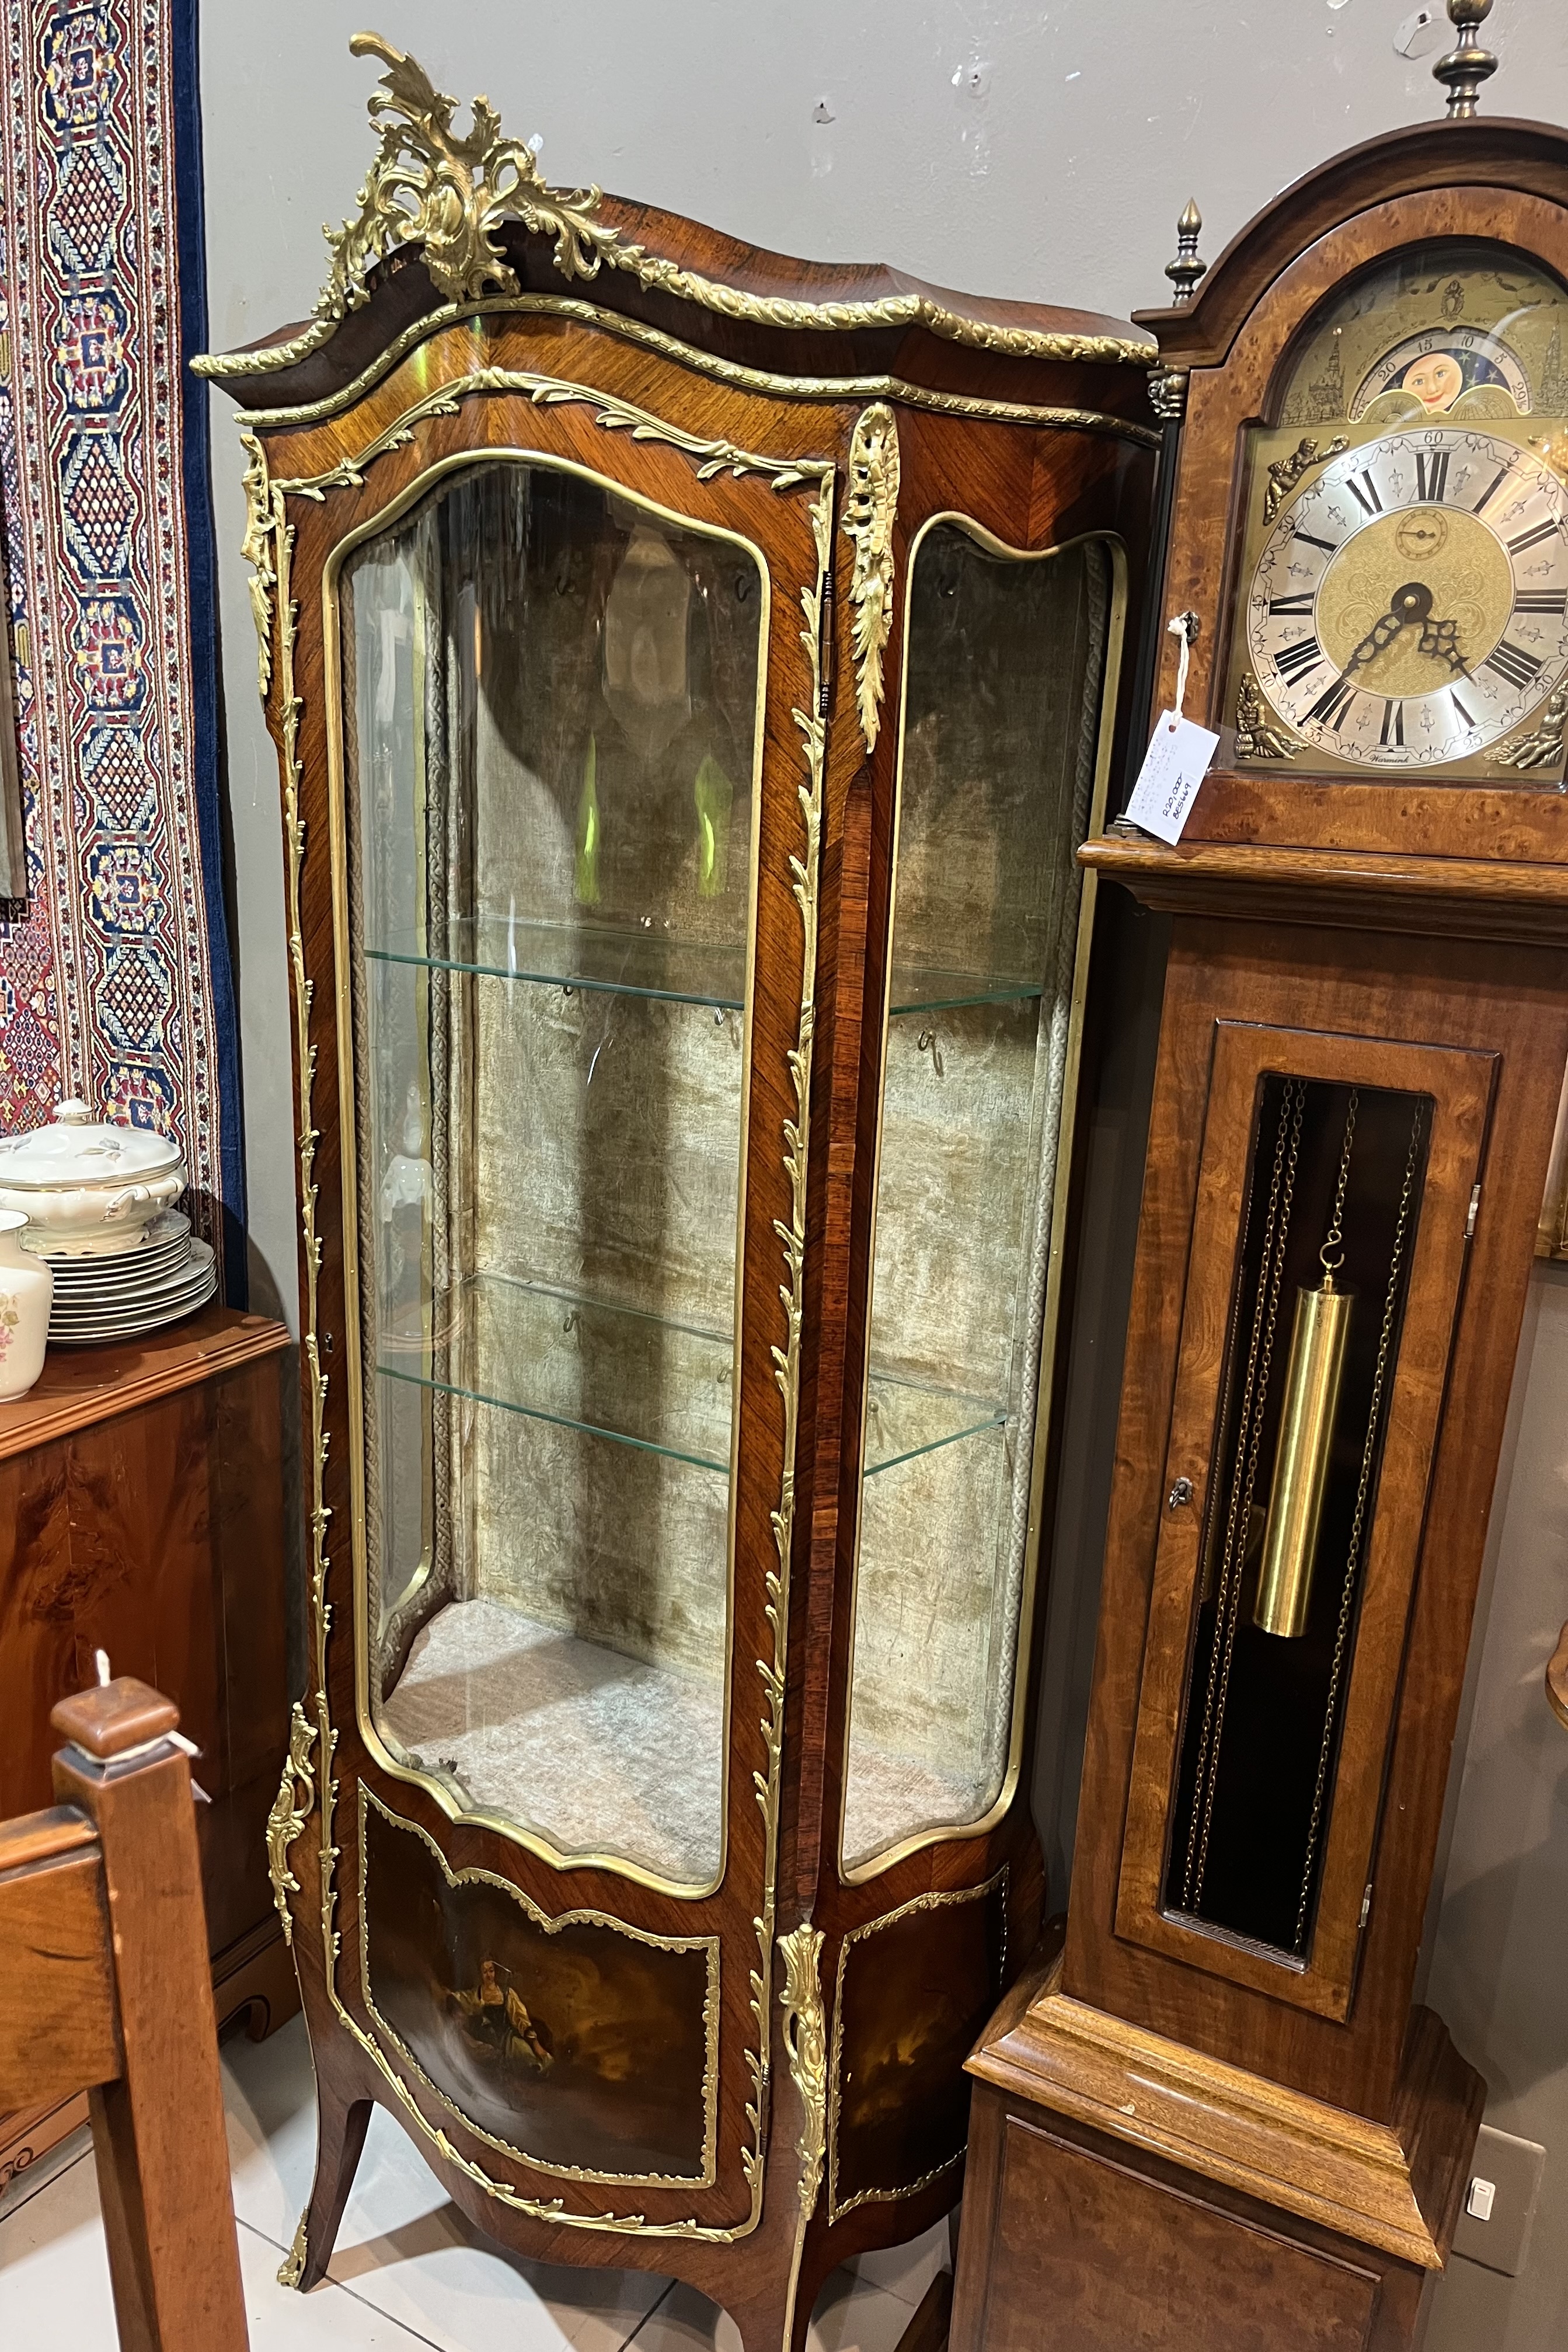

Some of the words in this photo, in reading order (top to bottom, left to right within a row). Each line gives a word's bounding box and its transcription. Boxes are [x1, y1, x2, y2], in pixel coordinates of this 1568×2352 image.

[1417, 338, 1433, 353] 15
[1461, 336, 1474, 348] 10
[1494, 352, 1508, 364] 5
[1378, 361, 1396, 382] 20
[1424, 431, 1444, 444] 60
[1509, 450, 1522, 463] 5
[1407, 451, 1452, 503] XII
[1278, 515, 1295, 534] 50
[1252, 595, 1263, 611] 45
[1260, 671, 1276, 688] 40
[1535, 674, 1554, 694] 20
[1305, 731, 1324, 743] 35
[1463, 732, 1483, 750] 25
[1369, 754, 1409, 764] Warmink
